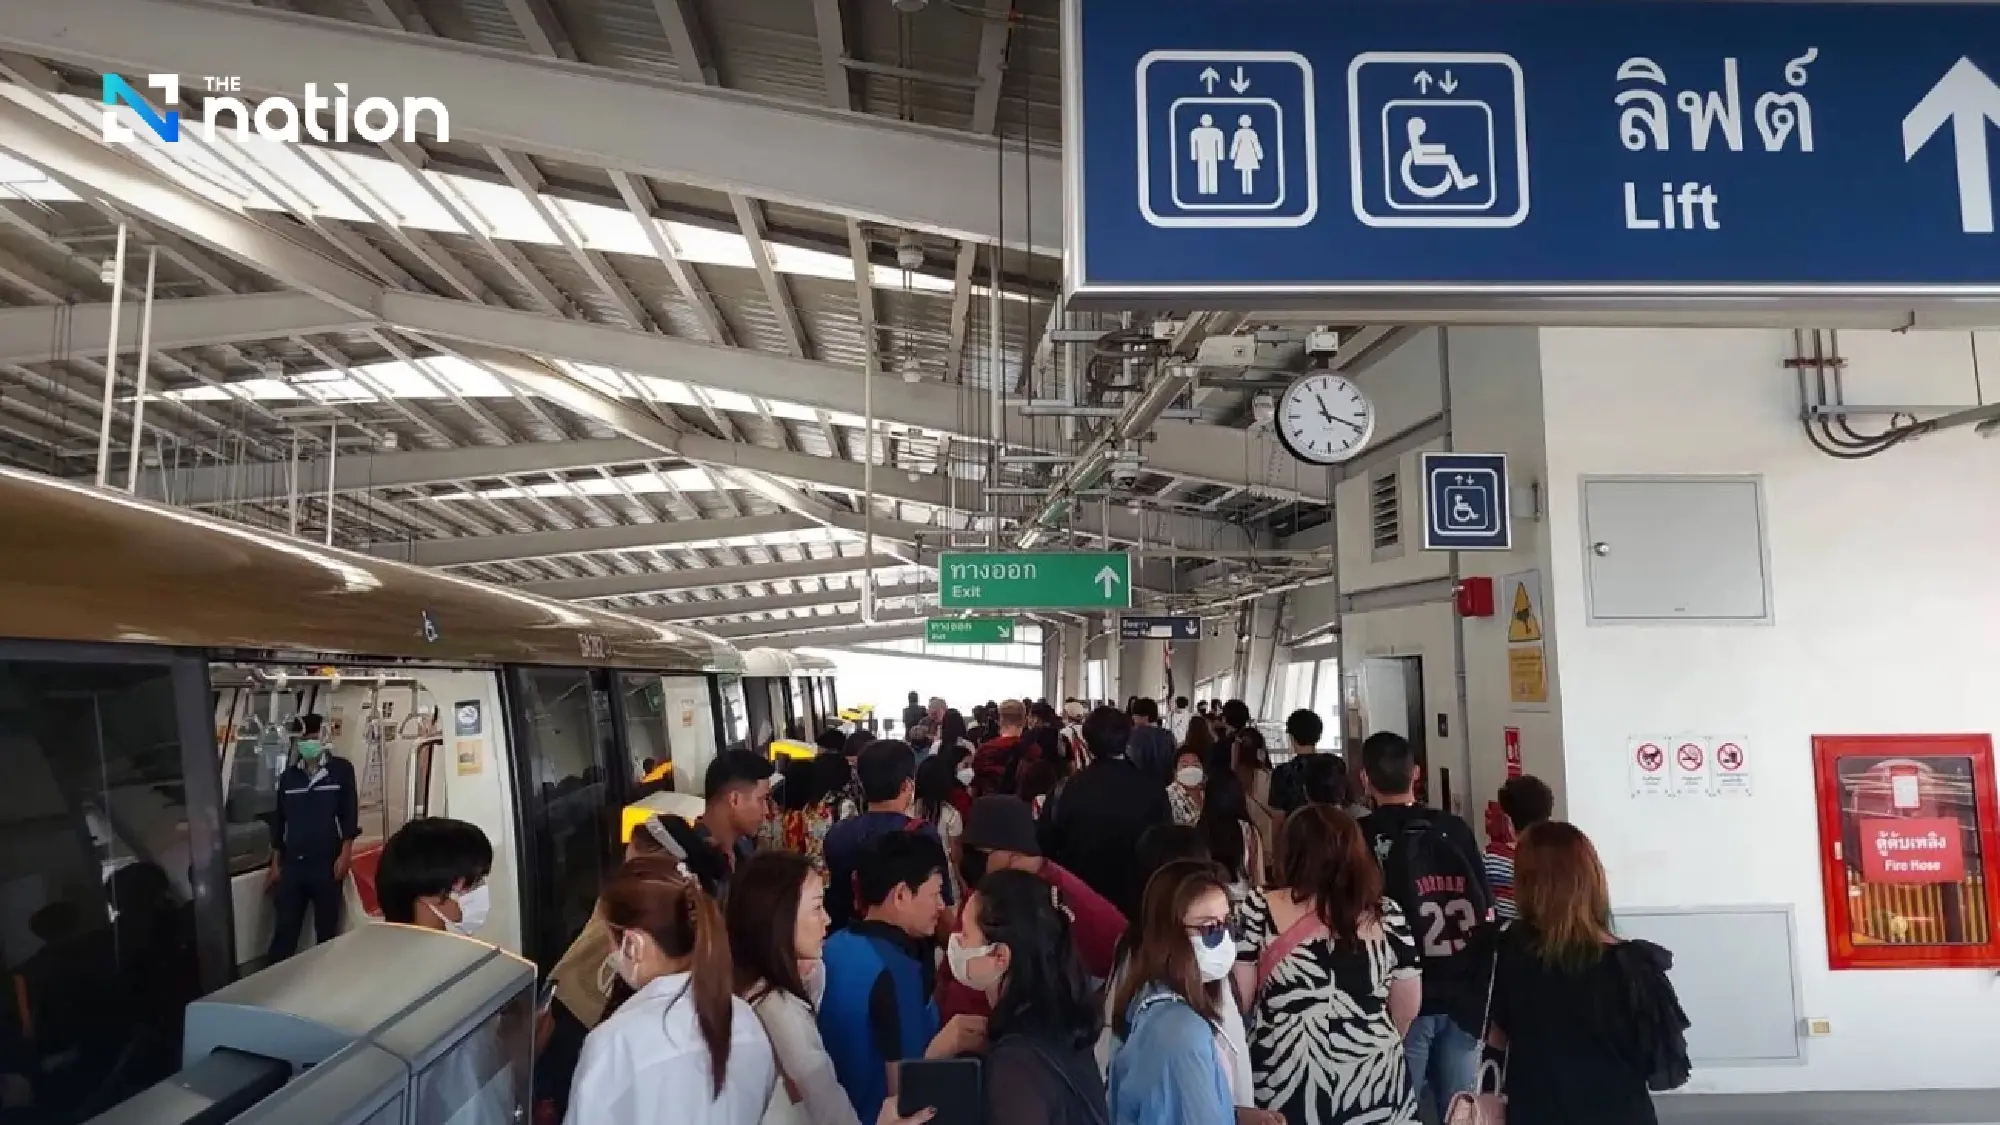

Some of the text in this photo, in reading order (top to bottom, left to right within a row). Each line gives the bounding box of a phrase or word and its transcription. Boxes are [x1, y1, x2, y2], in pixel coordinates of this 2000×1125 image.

[1614, 47, 1818, 152] ลิฟต์
[1624, 181, 1721, 229] Lift
[950, 563, 1037, 580] ทางออก
[952, 585, 982, 598] Exit
[1876, 830, 1947, 857] ตู้ดับเพลิง
[1884, 860, 1941, 872] Fire Hose
[1420, 899, 1476, 957] 23
